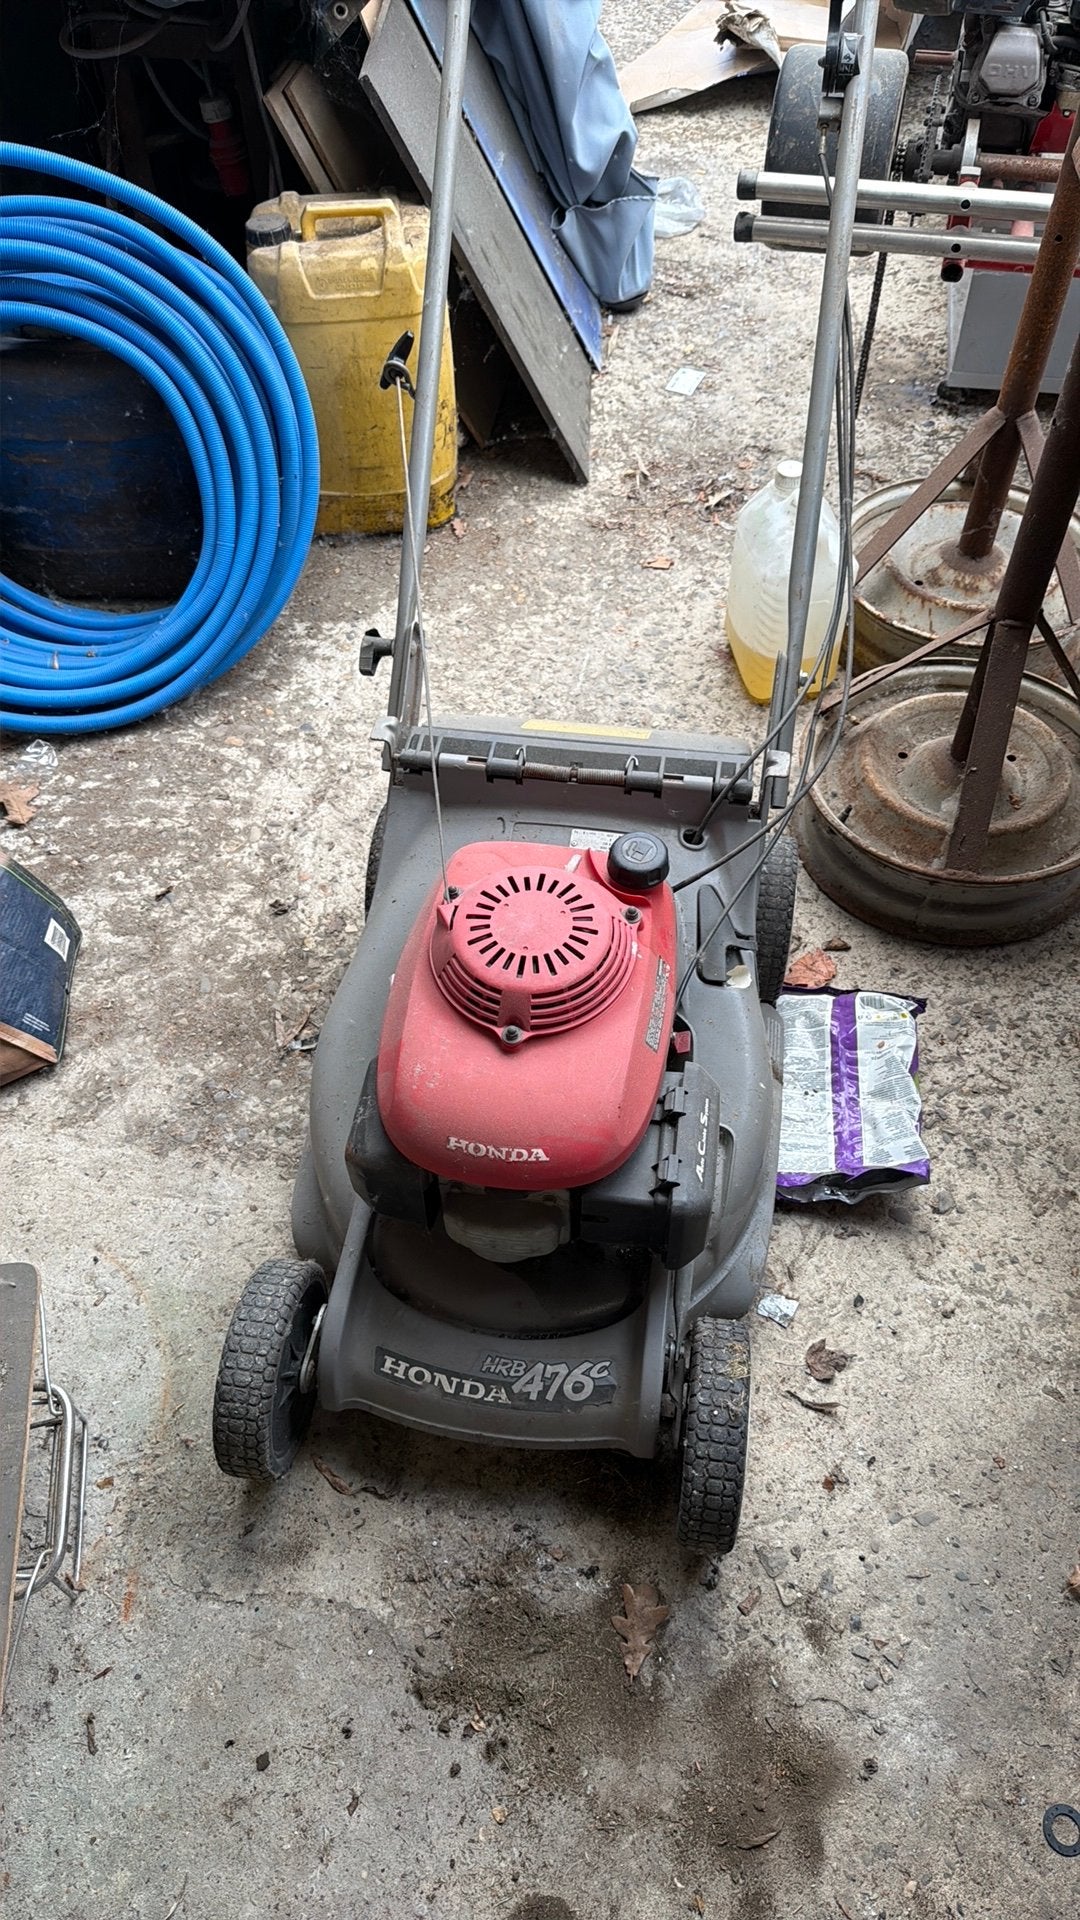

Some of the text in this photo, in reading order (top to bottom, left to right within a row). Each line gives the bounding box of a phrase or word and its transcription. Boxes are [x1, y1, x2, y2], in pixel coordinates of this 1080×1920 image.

[446, 1136, 550, 1162] HONDA
[481, 1354, 527, 1377] HRB
[380, 1355, 512, 1405] HONDA
